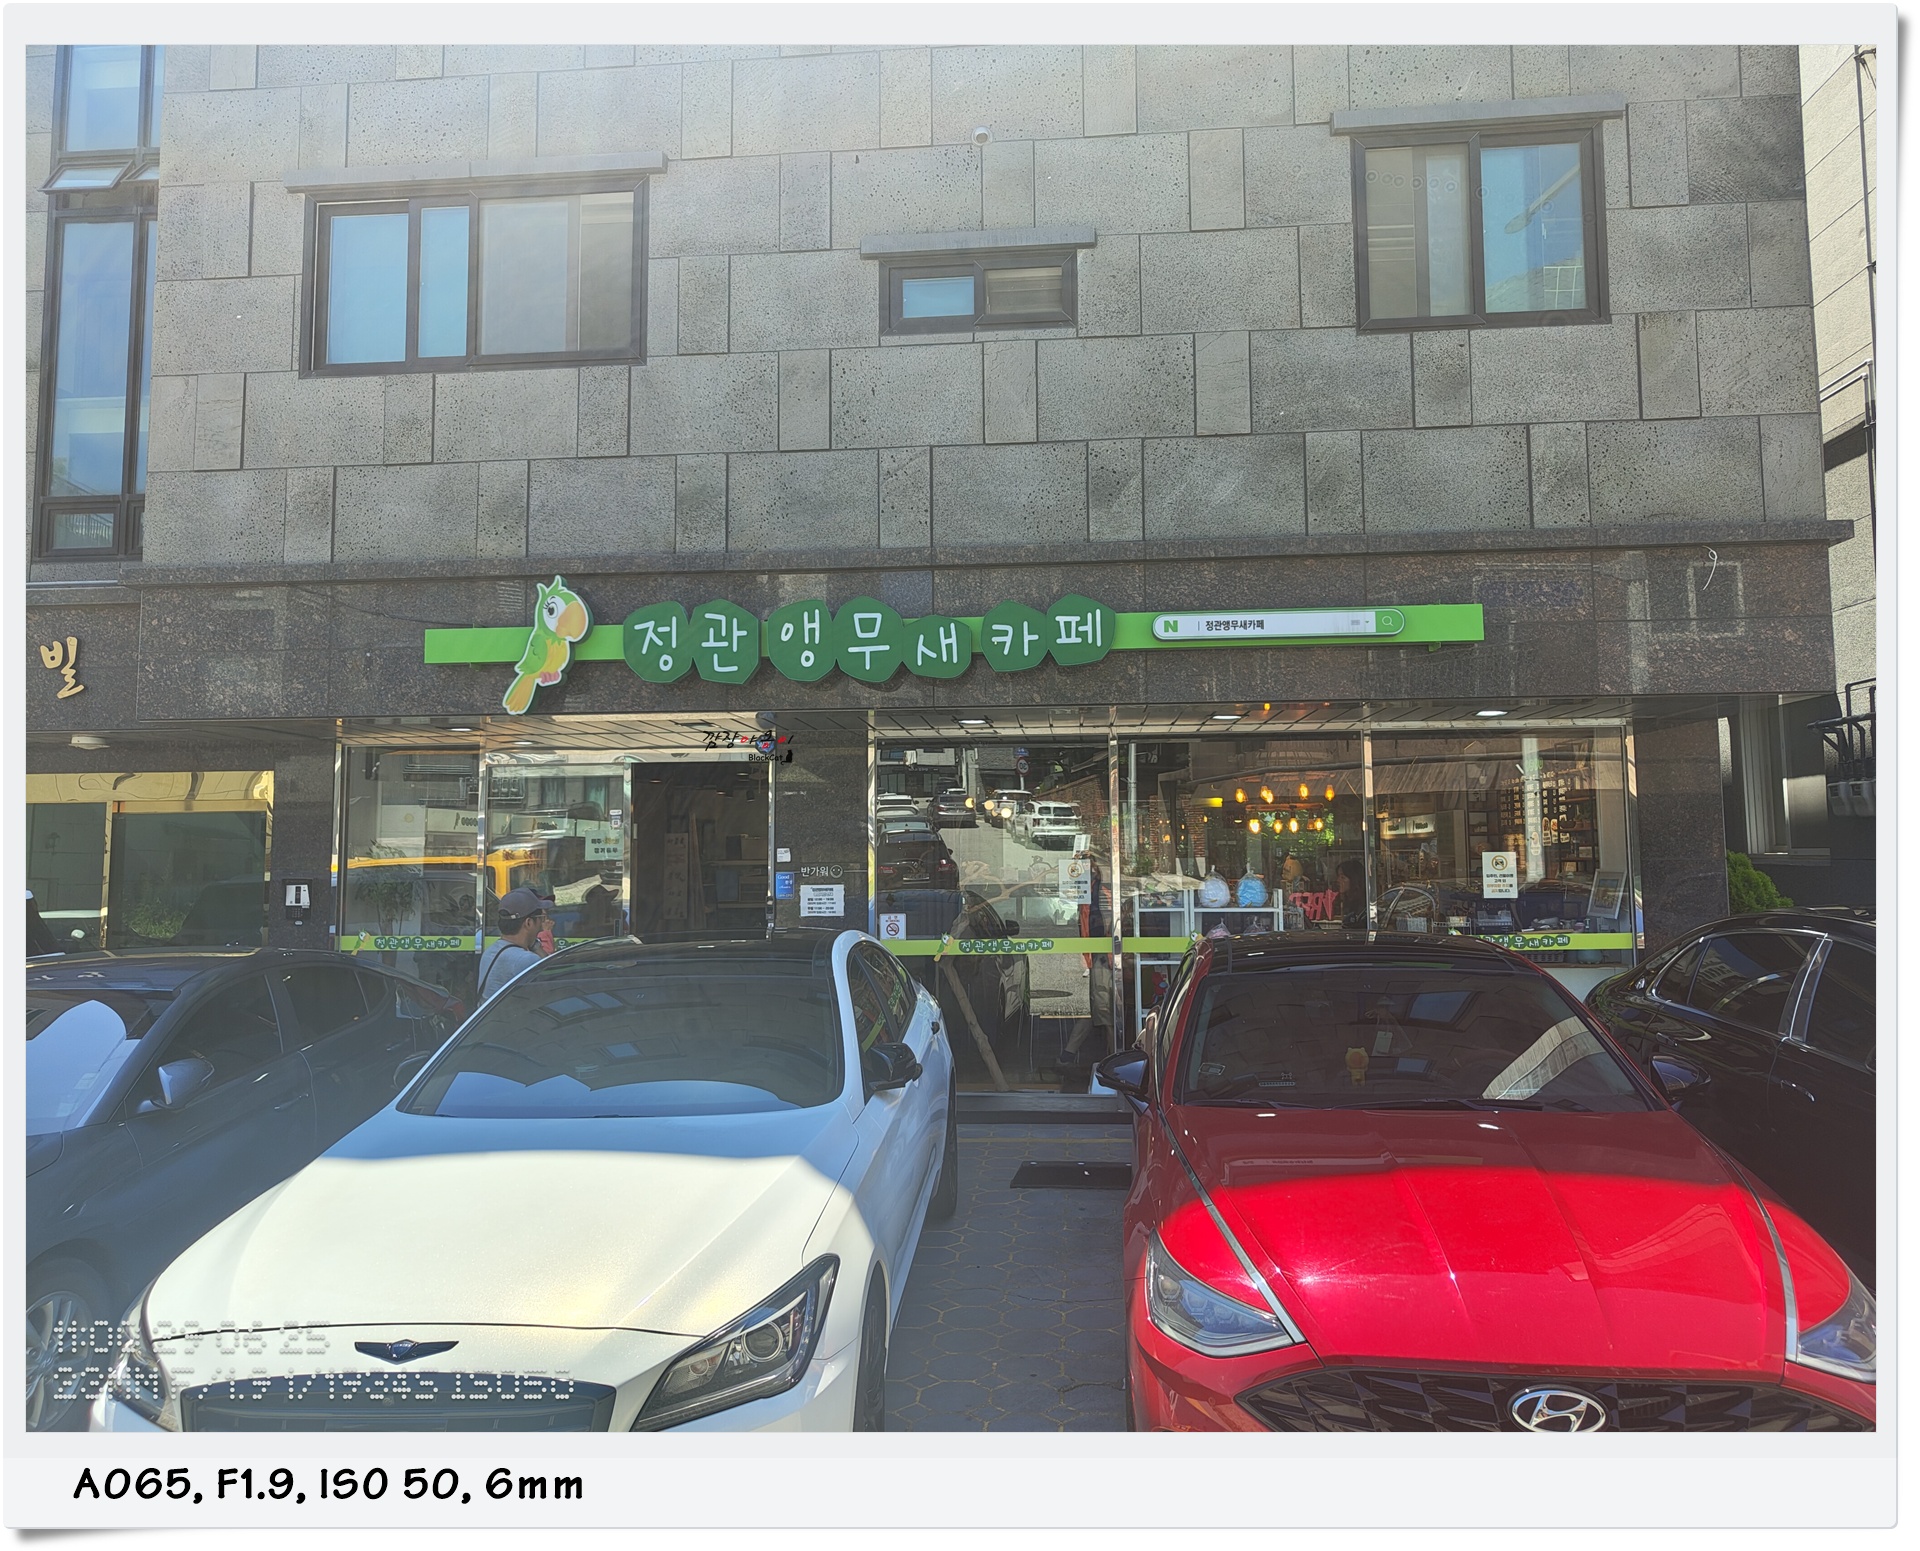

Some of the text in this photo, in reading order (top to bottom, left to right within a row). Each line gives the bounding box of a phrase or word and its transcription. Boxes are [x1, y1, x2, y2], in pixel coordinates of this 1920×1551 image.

[1163, 620, 1179, 633] N
[1205, 619, 1265, 631] 정관앵무새카페
[40, 636, 85, 698] 빌
[801, 866, 829, 877] 반가워
[375, 938, 461, 949] 정관앵무새카페
[960, 939, 1053, 952] 정관앵무새카페
